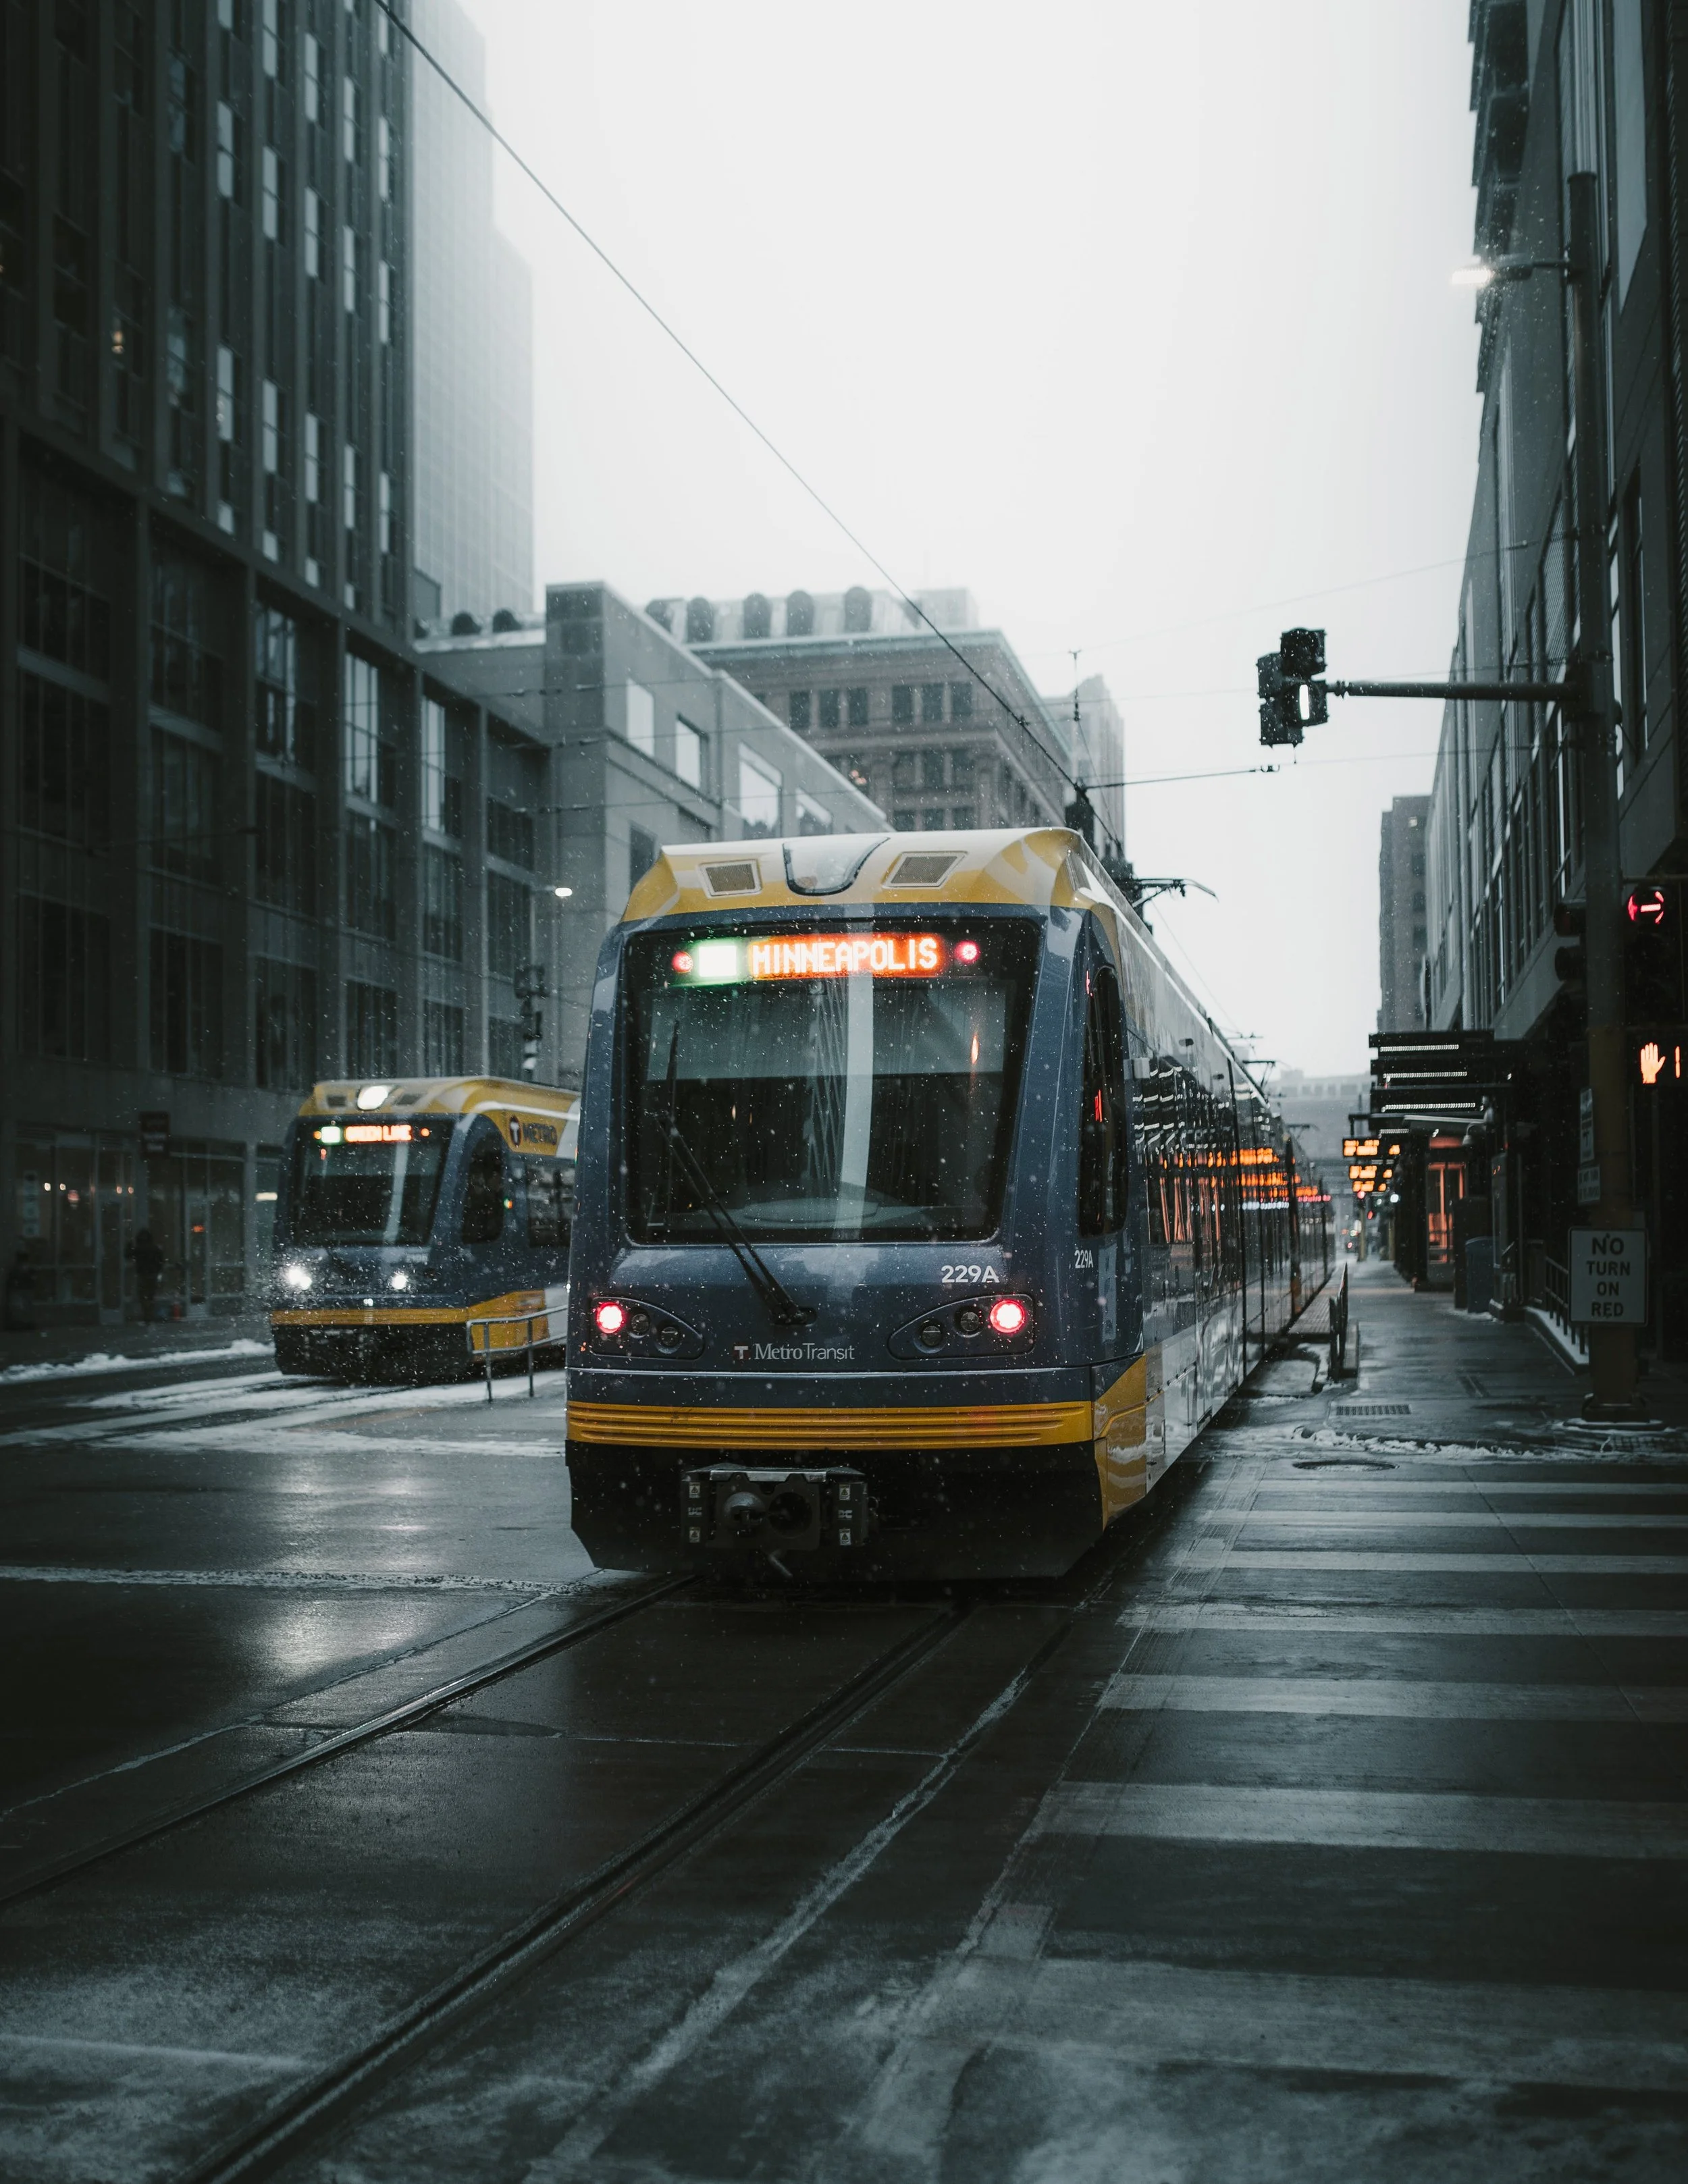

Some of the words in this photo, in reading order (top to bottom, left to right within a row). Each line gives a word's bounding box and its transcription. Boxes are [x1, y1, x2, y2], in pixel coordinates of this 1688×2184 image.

[752, 937, 938, 974] MINNEAPOLIS
[1592, 1237, 1625, 1255] NO
[1074, 1250, 1093, 1269] 229A
[1587, 1260, 1631, 1276] TURN
[941, 1264, 999, 1283] 229A
[1597, 1281, 1619, 1296] ON
[1591, 1302, 1624, 1317] RED
